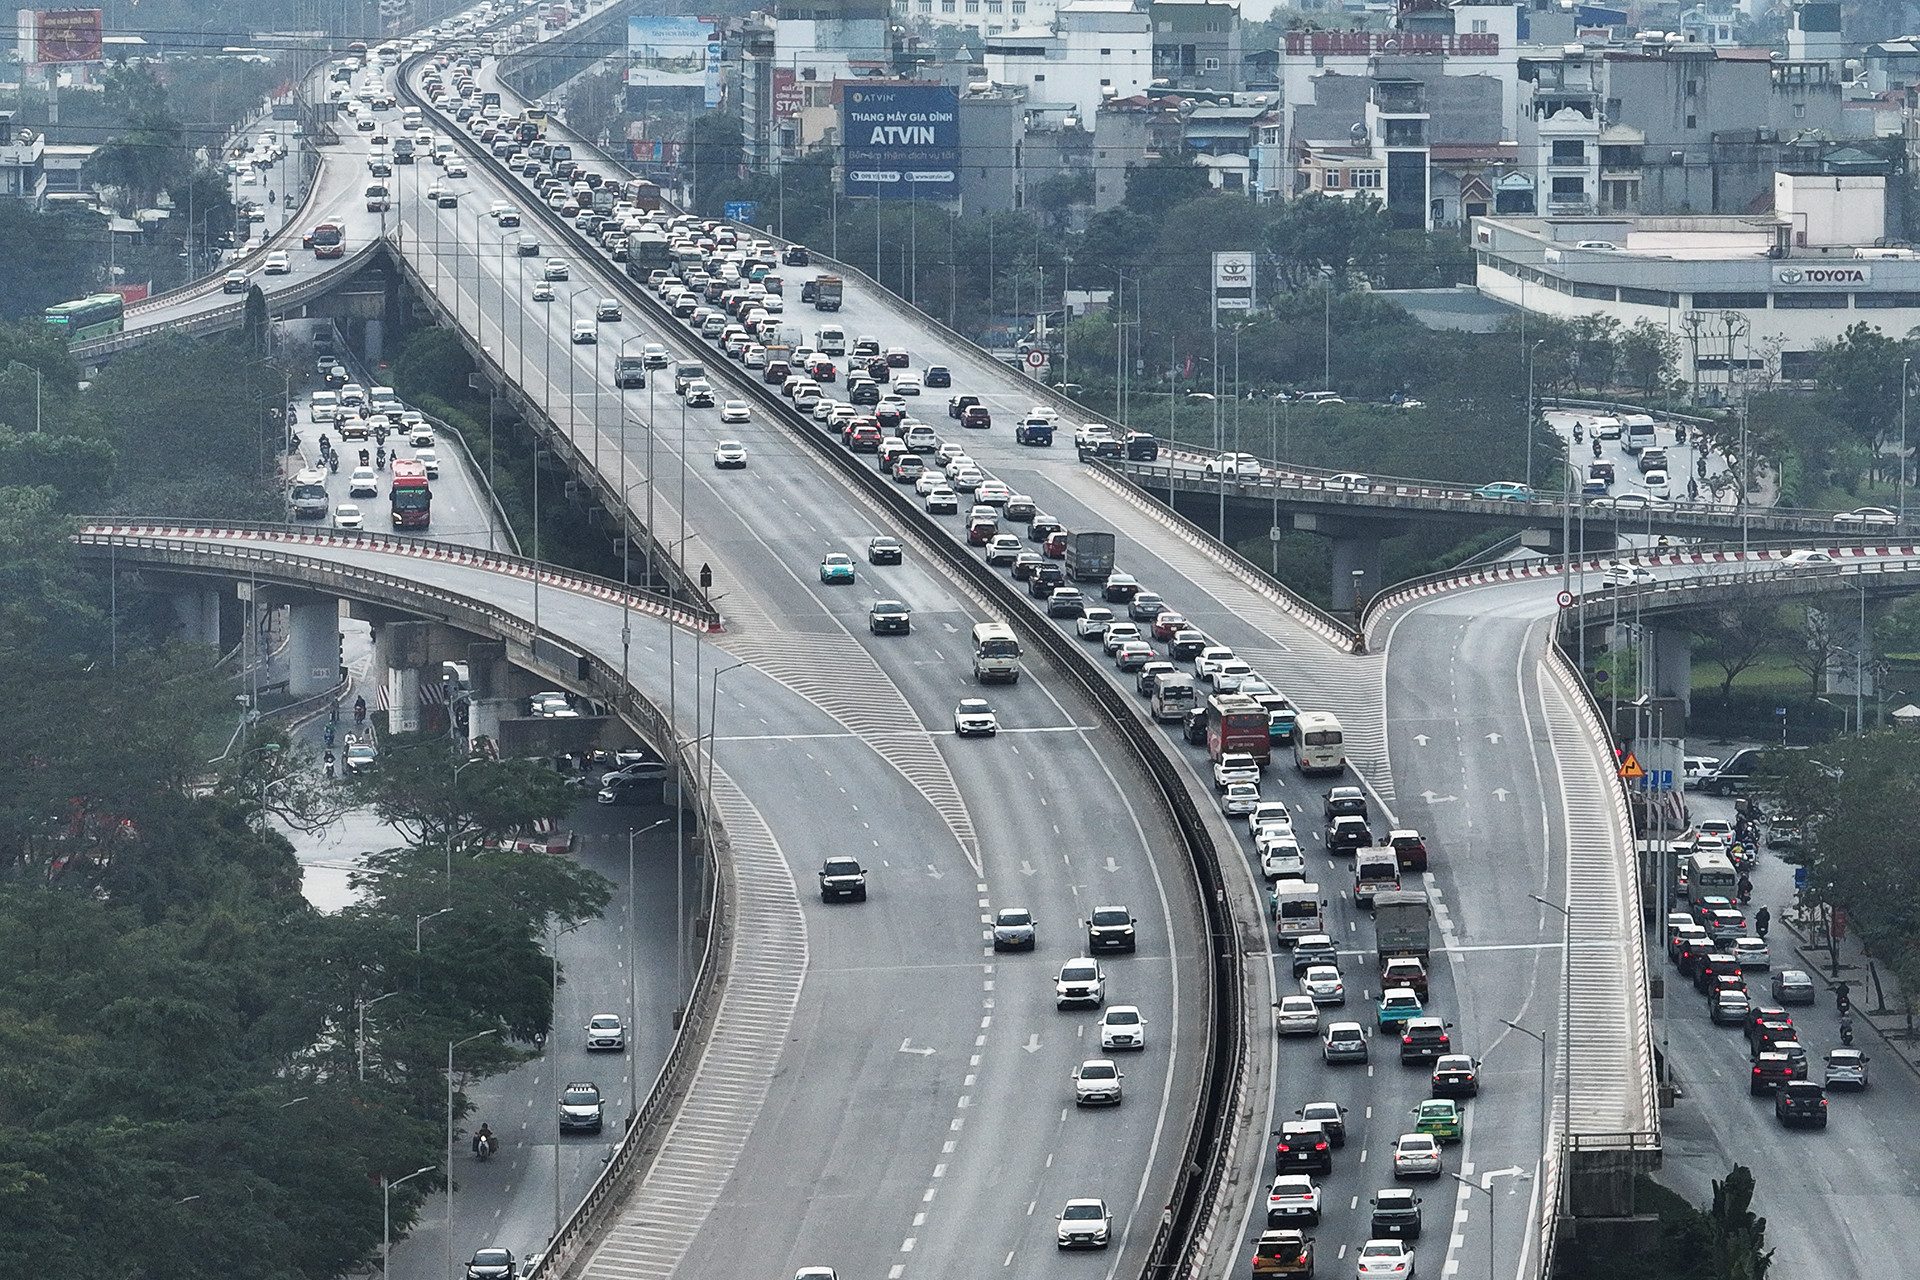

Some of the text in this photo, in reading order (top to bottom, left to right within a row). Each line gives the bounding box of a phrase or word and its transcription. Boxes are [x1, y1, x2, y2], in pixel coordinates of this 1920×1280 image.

[863, 94, 894, 102] ATVIN
[851, 111, 953, 121] THANG MÁY GIA ĐÌNH
[870, 126, 935, 145] ATVIN
[908, 151, 927, 160] dịch
[929, 152, 940, 160] vụ
[941, 150, 955, 159] tốt
[1805, 270, 1864, 282] TOYOTA
